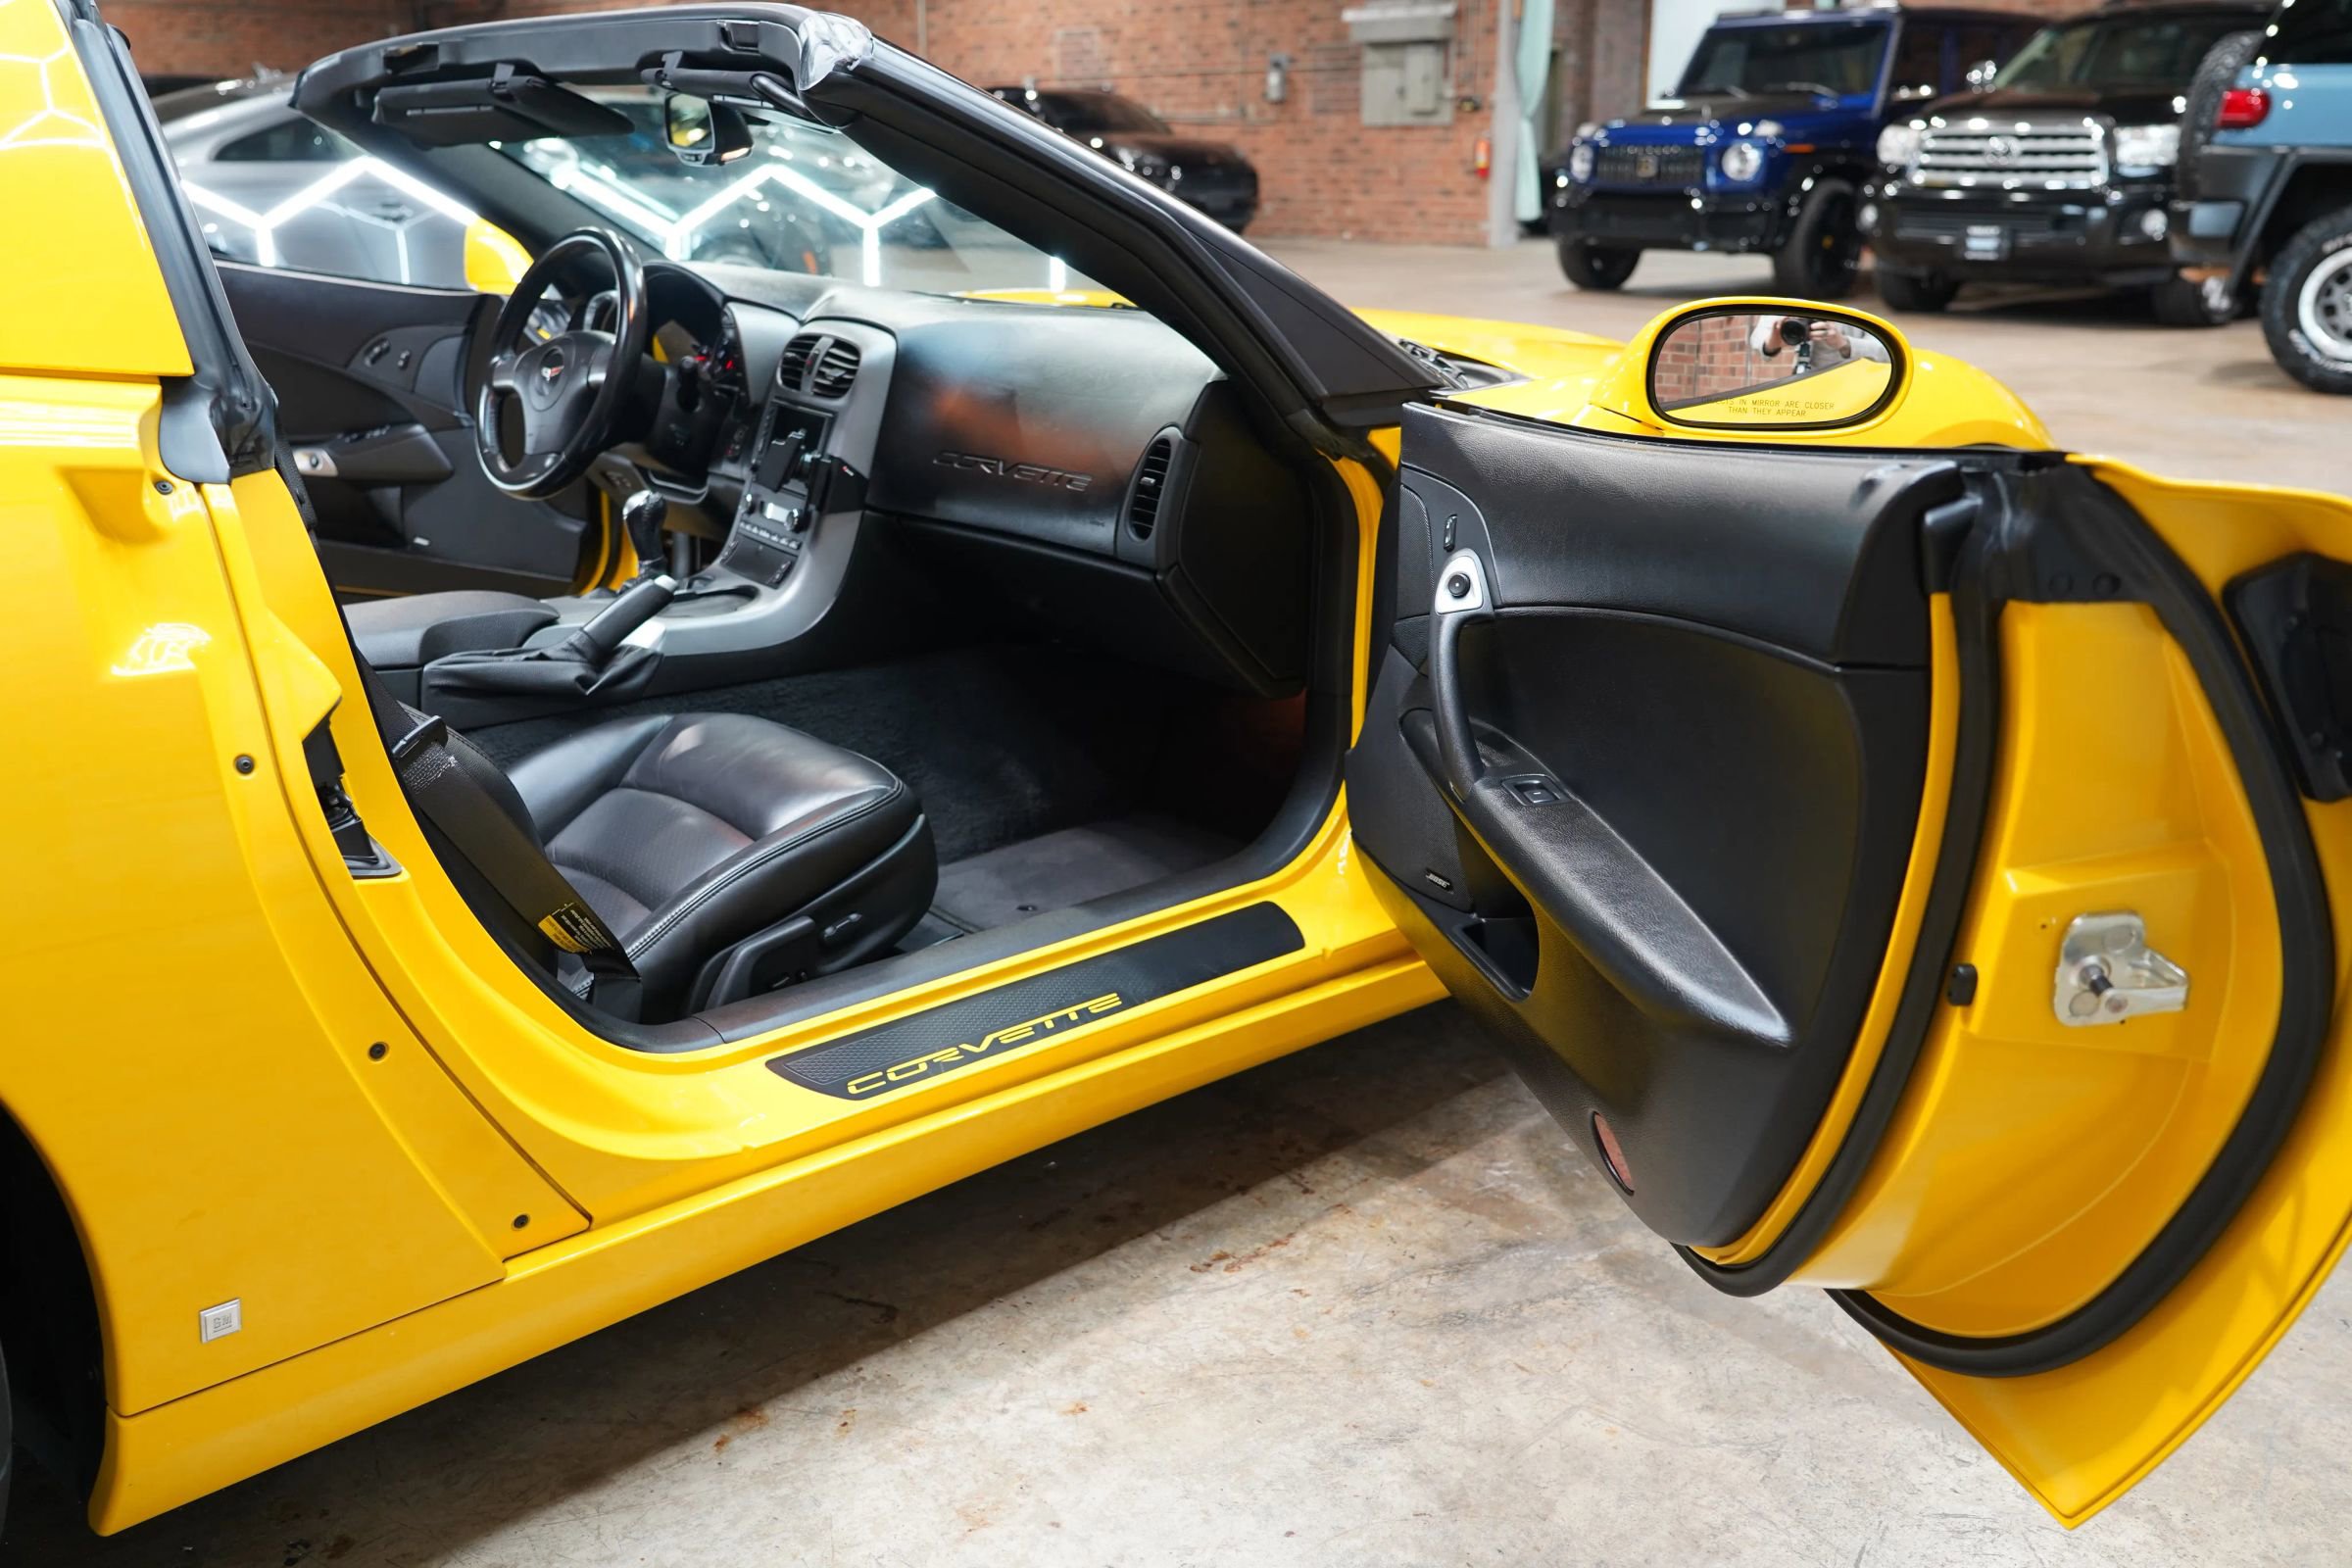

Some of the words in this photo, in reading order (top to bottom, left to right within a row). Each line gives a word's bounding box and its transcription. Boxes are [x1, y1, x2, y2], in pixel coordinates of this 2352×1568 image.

[1728, 406, 1748, 415] THAN
[1753, 407, 1772, 416] THEY
[1751, 399, 1781, 408] MIRROR
[1804, 402, 1835, 411] CLOSER
[932, 451, 1093, 492] CORVETTE
[847, 992, 1123, 1095] CORVETTE
[213, 1313, 232, 1329] GM
